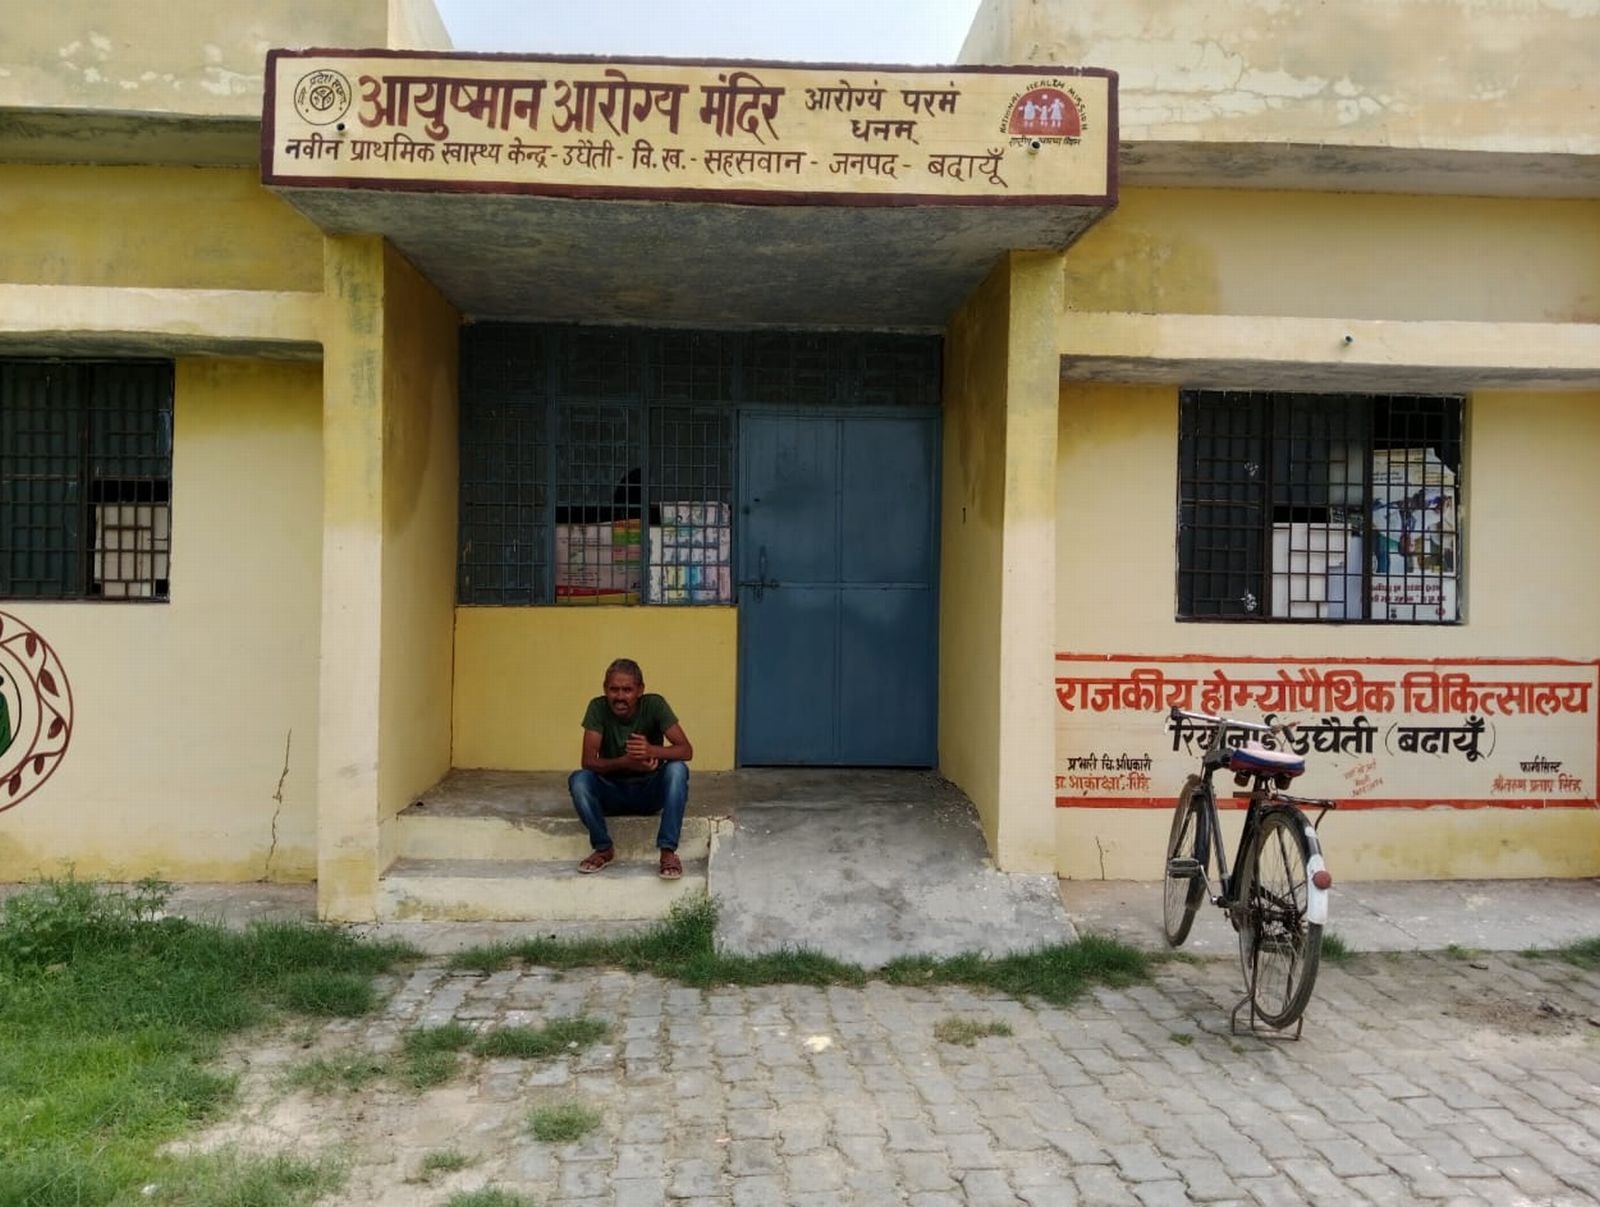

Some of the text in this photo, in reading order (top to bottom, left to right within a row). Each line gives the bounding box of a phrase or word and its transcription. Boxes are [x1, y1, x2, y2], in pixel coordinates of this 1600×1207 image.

[358, 69, 785, 145] आयुष्मान आरोग्य मंदिर
[805, 78, 961, 117] आरोग्यं परमं
[1067, 88, 1088, 131] MISSION
[851, 119, 919, 144] धनम्
[285, 133, 344, 160] नवीन
[350, 133, 435, 163] प्राथमिक
[442, 142, 503, 166] स्वास्थ्य
[927, 146, 1008, 188] बदायूँ
[1055, 667, 1592, 717] राजकीय होम्योपैथिक चिकित्सालय
